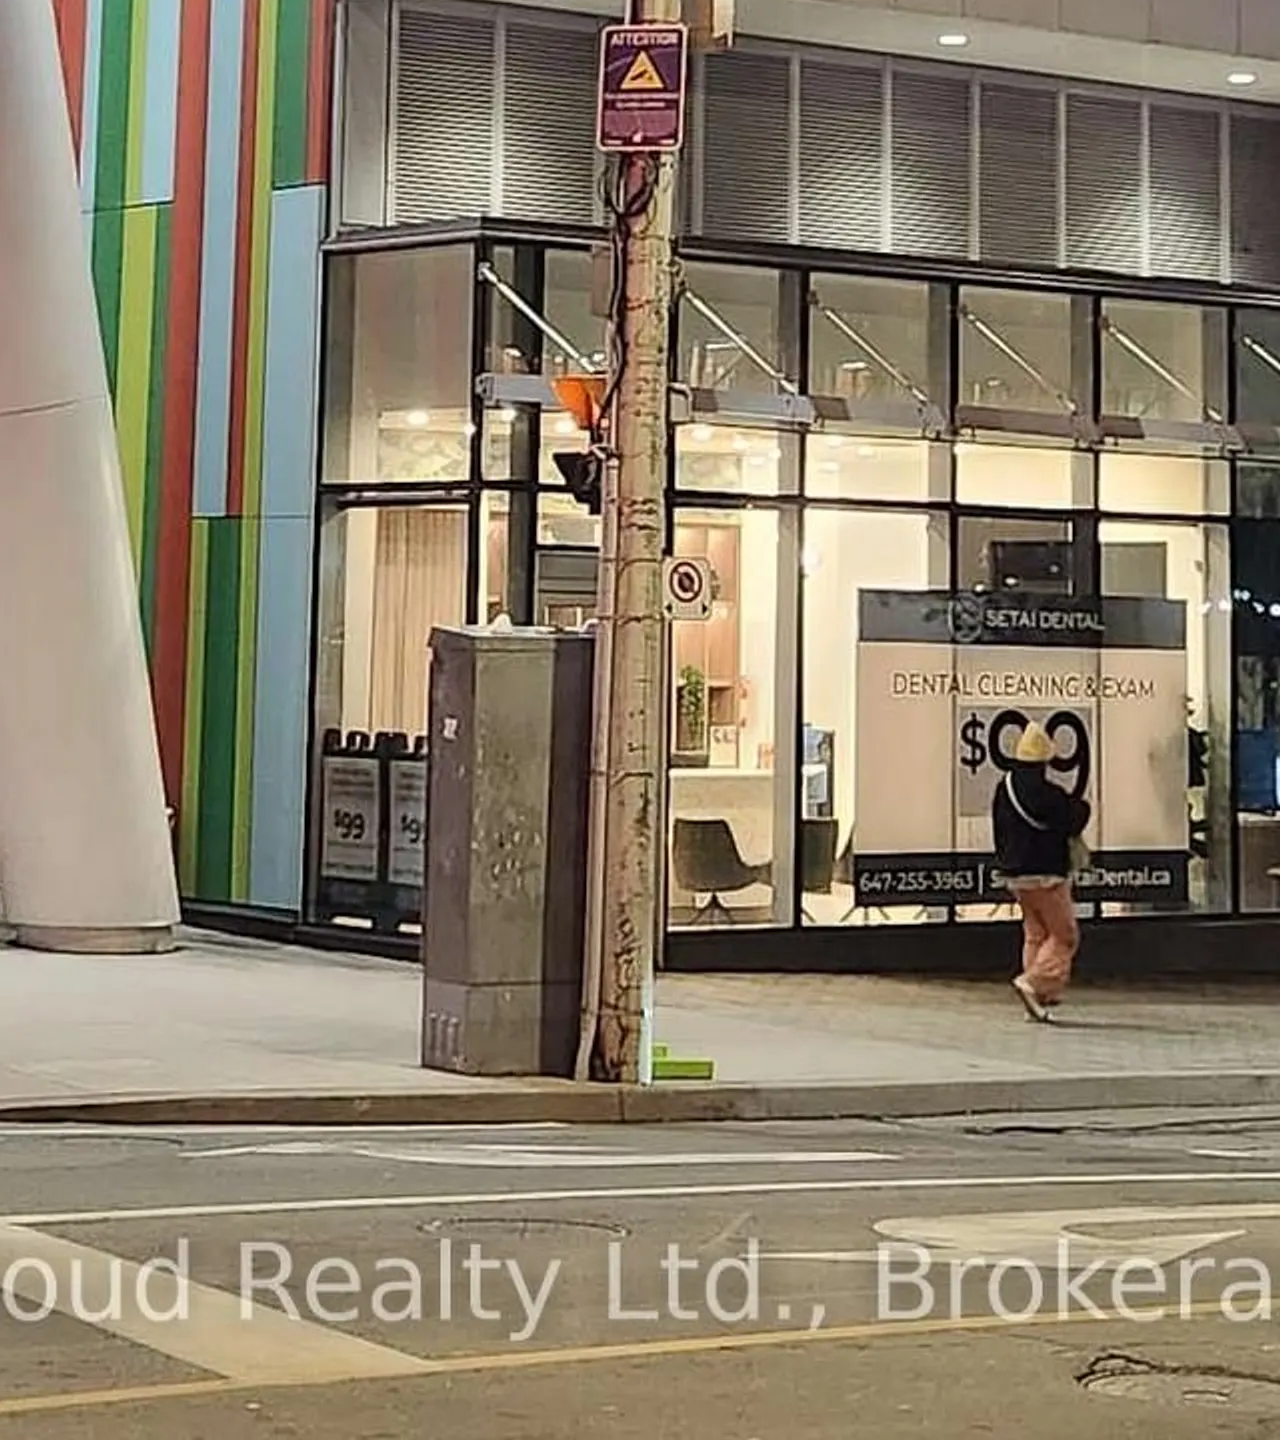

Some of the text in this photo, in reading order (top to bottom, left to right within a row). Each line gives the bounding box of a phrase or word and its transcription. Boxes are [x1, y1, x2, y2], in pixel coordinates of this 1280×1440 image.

[986, 608, 1105, 631] SETAI DENTAL
[892, 672, 1154, 698] DENTAL CLEANING & EXAM
